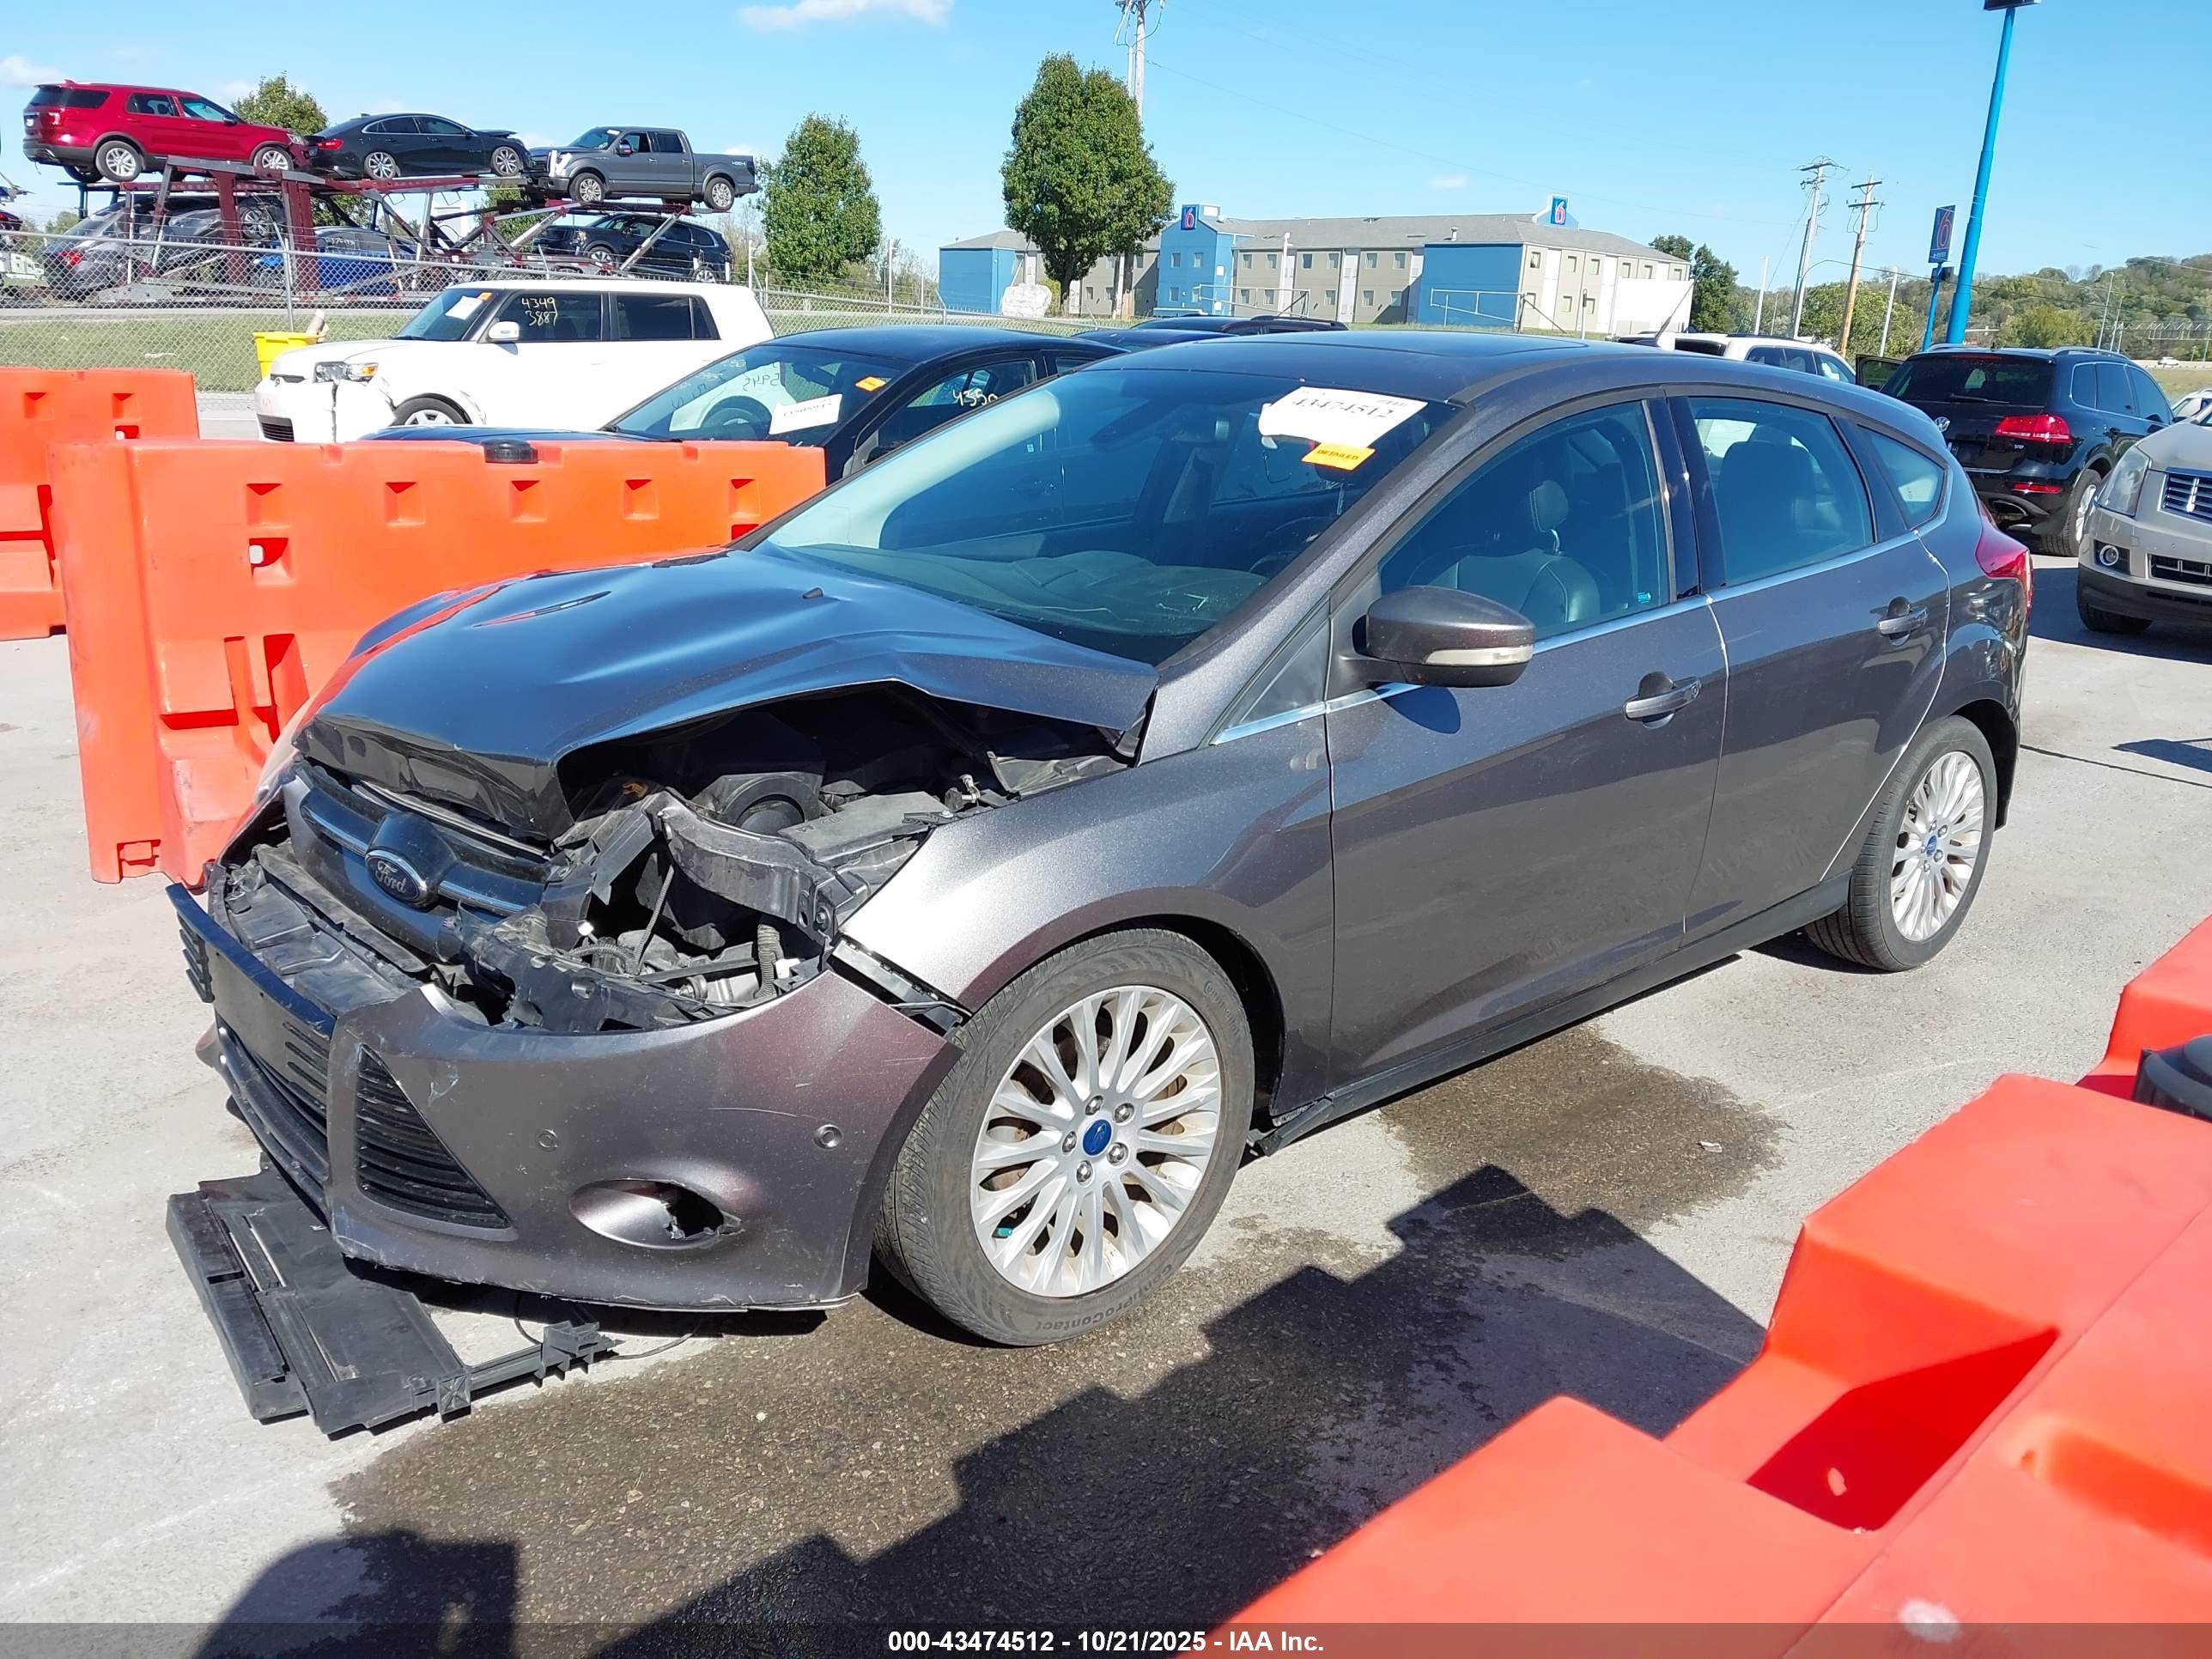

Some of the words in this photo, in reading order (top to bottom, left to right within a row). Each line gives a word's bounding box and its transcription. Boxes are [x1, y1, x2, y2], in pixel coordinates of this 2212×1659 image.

[1185, 207, 1194, 228] 6
[1555, 200, 1565, 223] 6
[1937, 207, 1952, 250] 6
[521, 297, 556, 311] 4349
[525, 309, 558, 326] 3887
[1316, 449, 1359, 460] DETAILED
[375, 860, 407, 893] Ford
